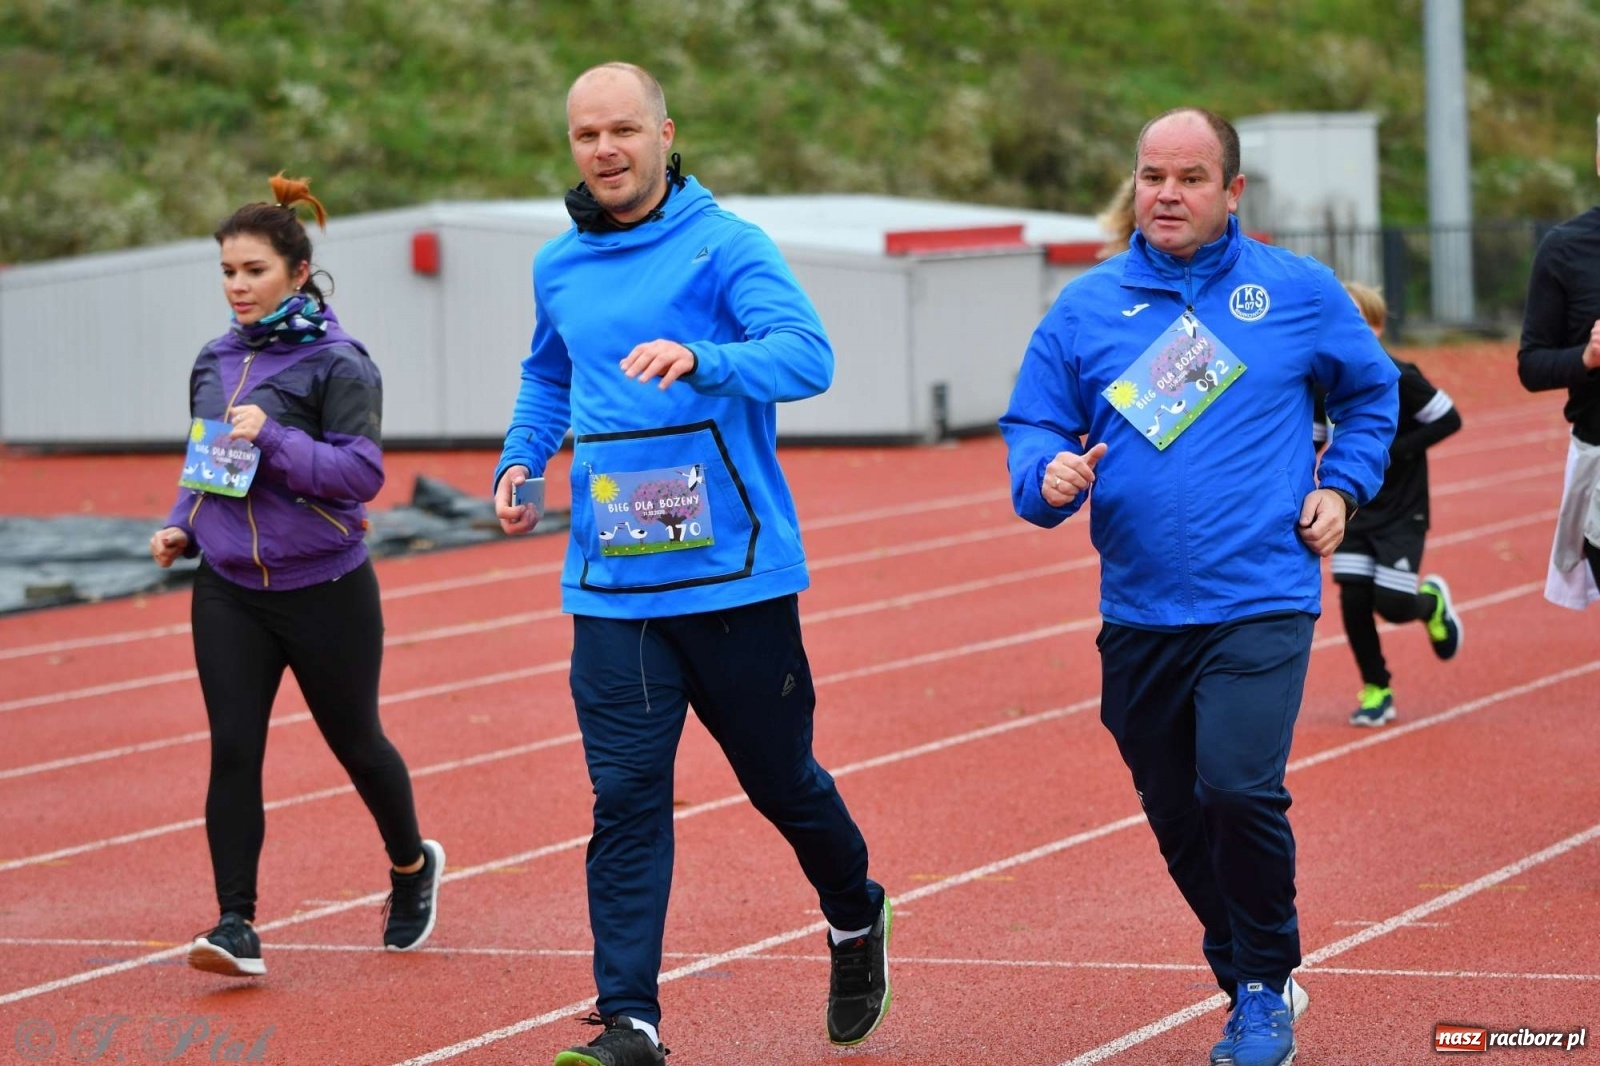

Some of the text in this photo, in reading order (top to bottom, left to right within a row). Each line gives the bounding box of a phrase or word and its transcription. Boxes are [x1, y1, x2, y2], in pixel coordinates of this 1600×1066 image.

[1236, 287, 1263, 308] LKS
[1244, 301, 1255, 310] 07
[1195, 360, 1230, 392] 092
[1135, 389, 1156, 410] BIEG
[1156, 372, 1175, 390] DLA
[222, 472, 249, 487] 045
[608, 502, 630, 513] BIEG
[634, 501, 654, 511] DLA
[665, 522, 701, 542] 170
